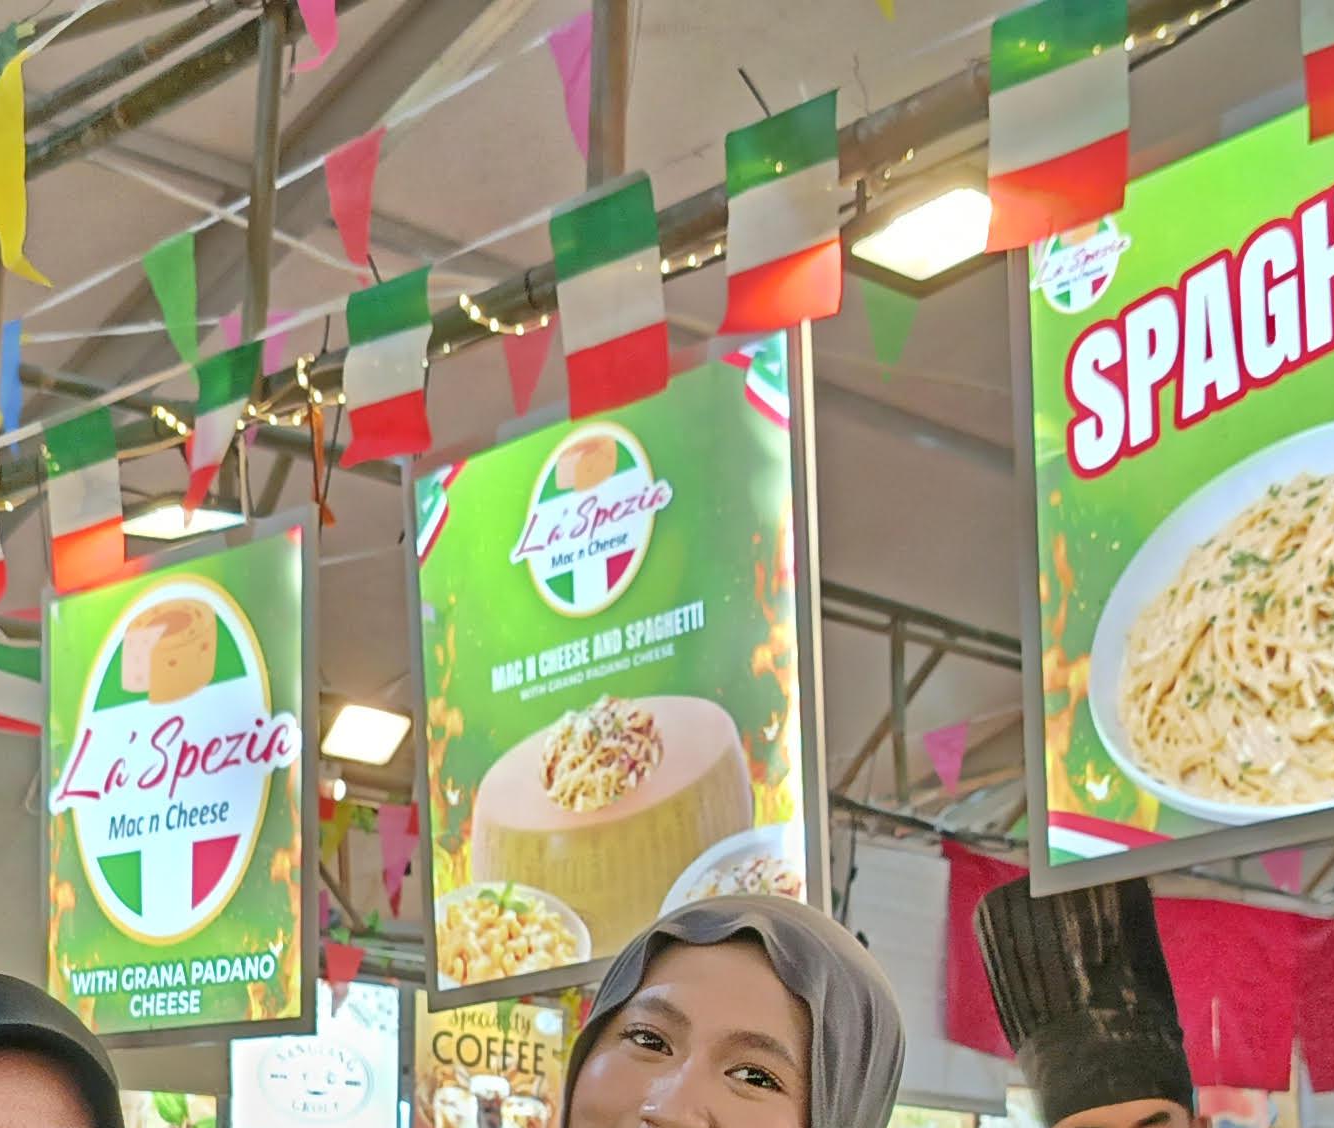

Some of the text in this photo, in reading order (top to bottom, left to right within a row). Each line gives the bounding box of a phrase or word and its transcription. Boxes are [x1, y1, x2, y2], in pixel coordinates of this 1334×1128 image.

[587, 533, 629, 557] Cheese
[491, 600, 705, 693] MAC N CHEESE AND SPAGHETTI
[633, 642, 676, 667] CHEESE
[108, 801, 230, 840] Mac n Cheese
[71, 954, 275, 995] WITH GRANA PADANO
[129, 990, 201, 1017] CHEESE
[432, 1031, 546, 1076] COFFEE
